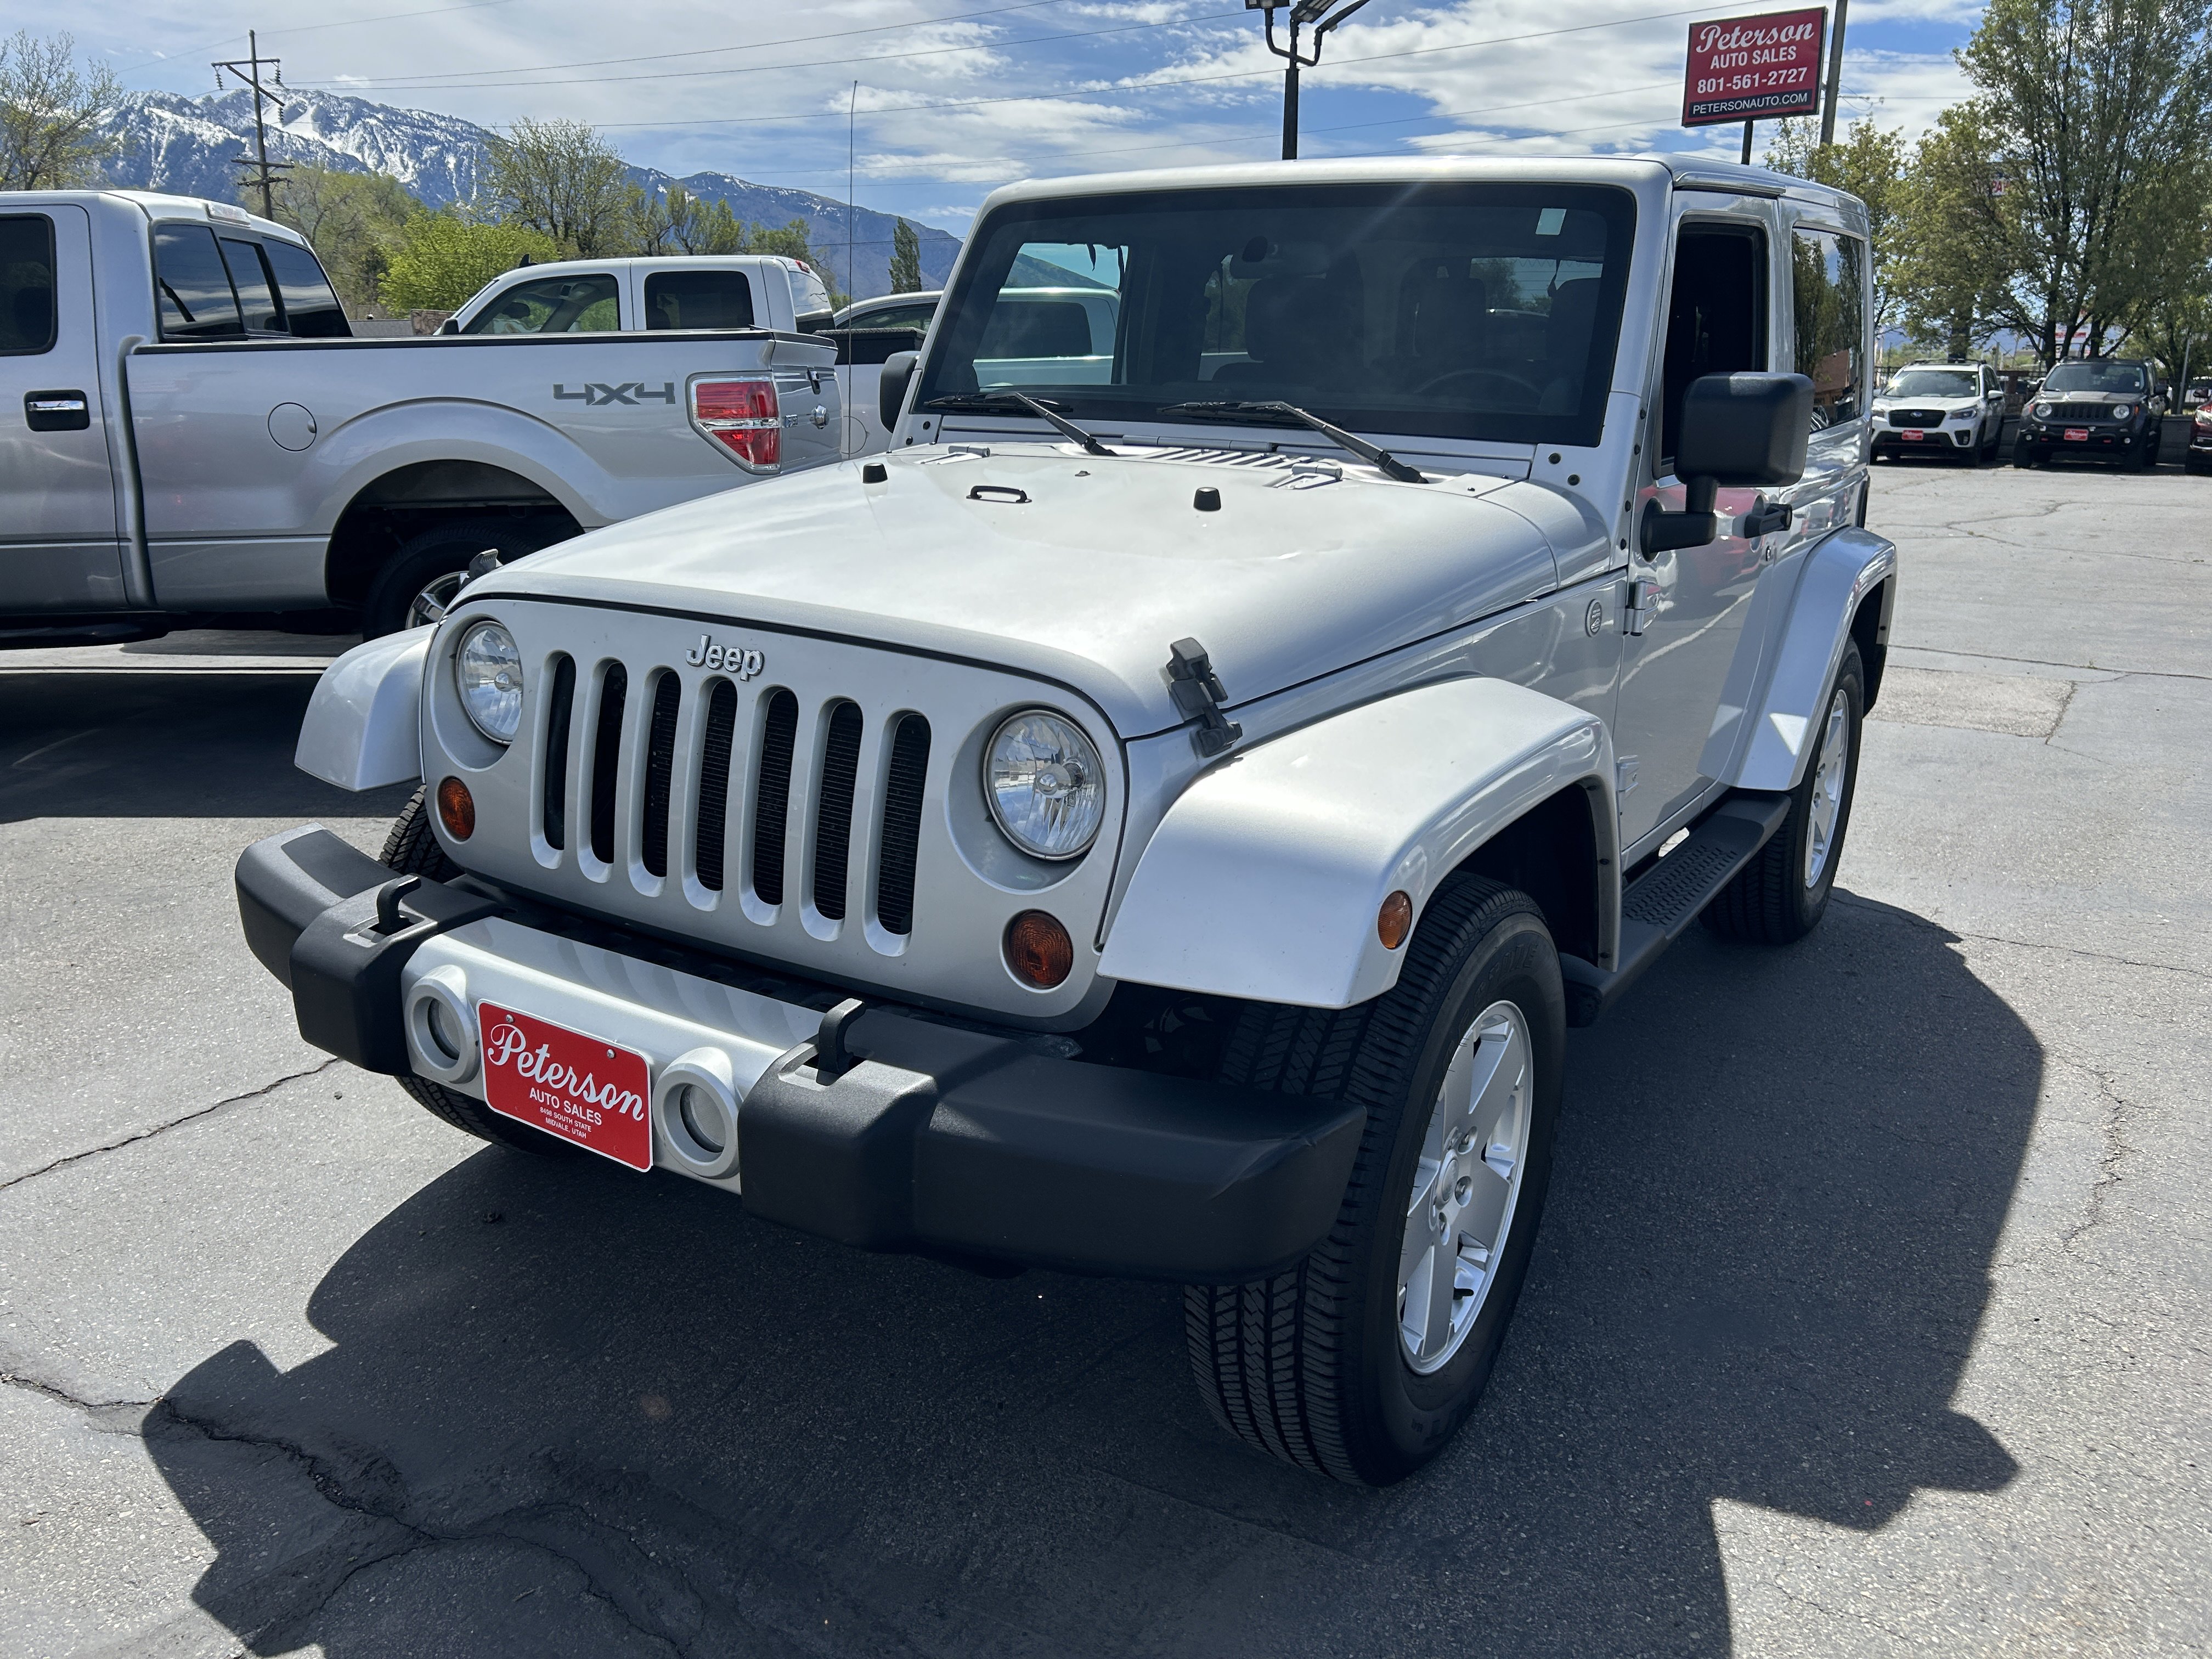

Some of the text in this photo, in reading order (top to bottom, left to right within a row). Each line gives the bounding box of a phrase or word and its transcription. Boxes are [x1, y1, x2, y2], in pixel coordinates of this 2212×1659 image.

[1696, 22, 1814, 53] Peterson
[1710, 46, 1797, 69] AUTO SALES
[1697, 67, 1808, 94] 801-561-2727
[1692, 92, 1808, 115] PETERSONAUTO.COM
[553, 382, 676, 405] 4X4
[686, 634, 764, 682] Jeep
[487, 1023, 644, 1121] Peterson
[529, 1087, 602, 1126] AUTO SALES
[545, 1116, 586, 1139] MIDVALE, UTAH
[554, 1111, 573, 1125] SOUTH
[574, 1120, 592, 1132] STATE
